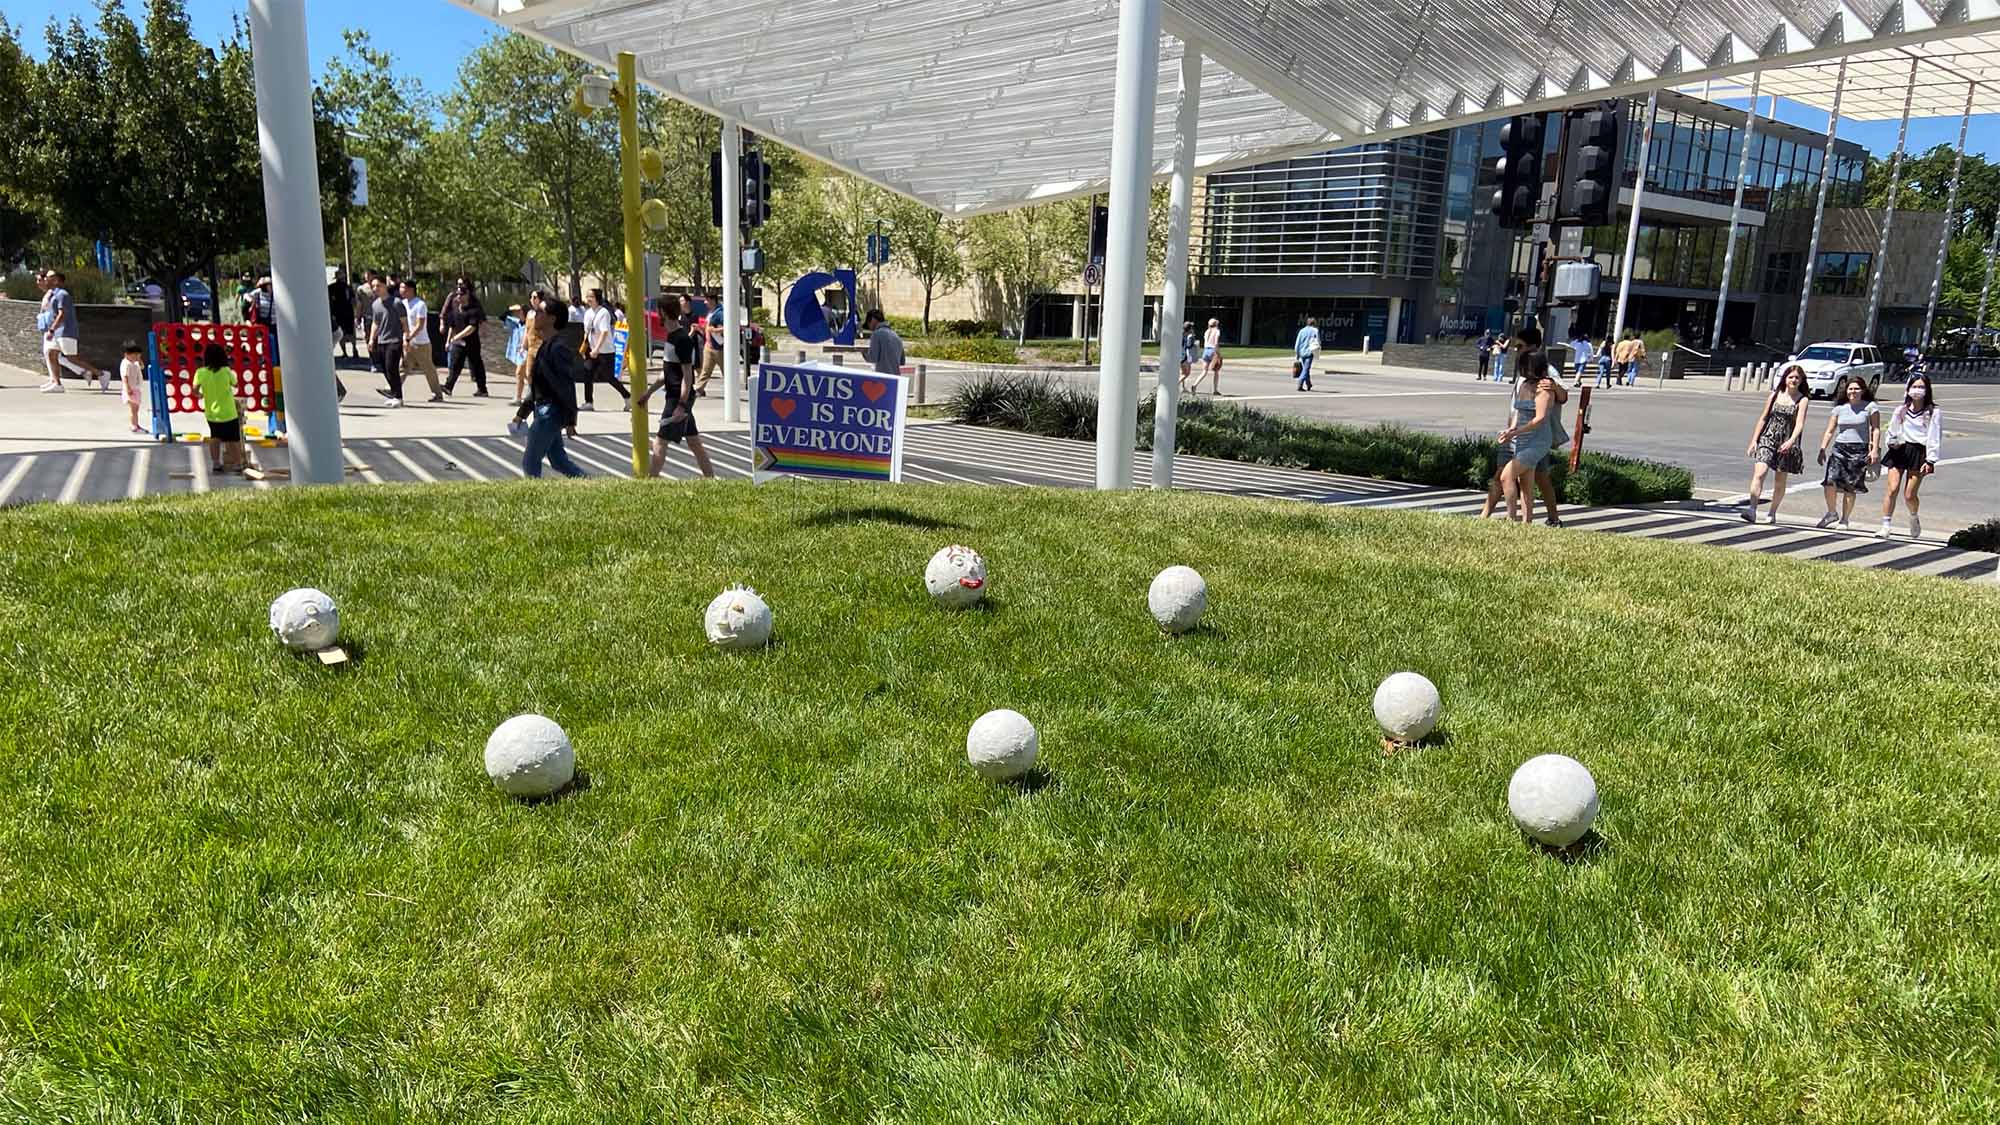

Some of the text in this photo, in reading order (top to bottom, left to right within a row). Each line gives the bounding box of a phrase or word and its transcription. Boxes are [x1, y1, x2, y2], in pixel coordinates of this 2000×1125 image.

[1297, 312, 1354, 328] Mndavi
[764, 369, 853, 400] DAVIS
[810, 402, 892, 431] IS FOR
[756, 424, 892, 455] EVERYONE
